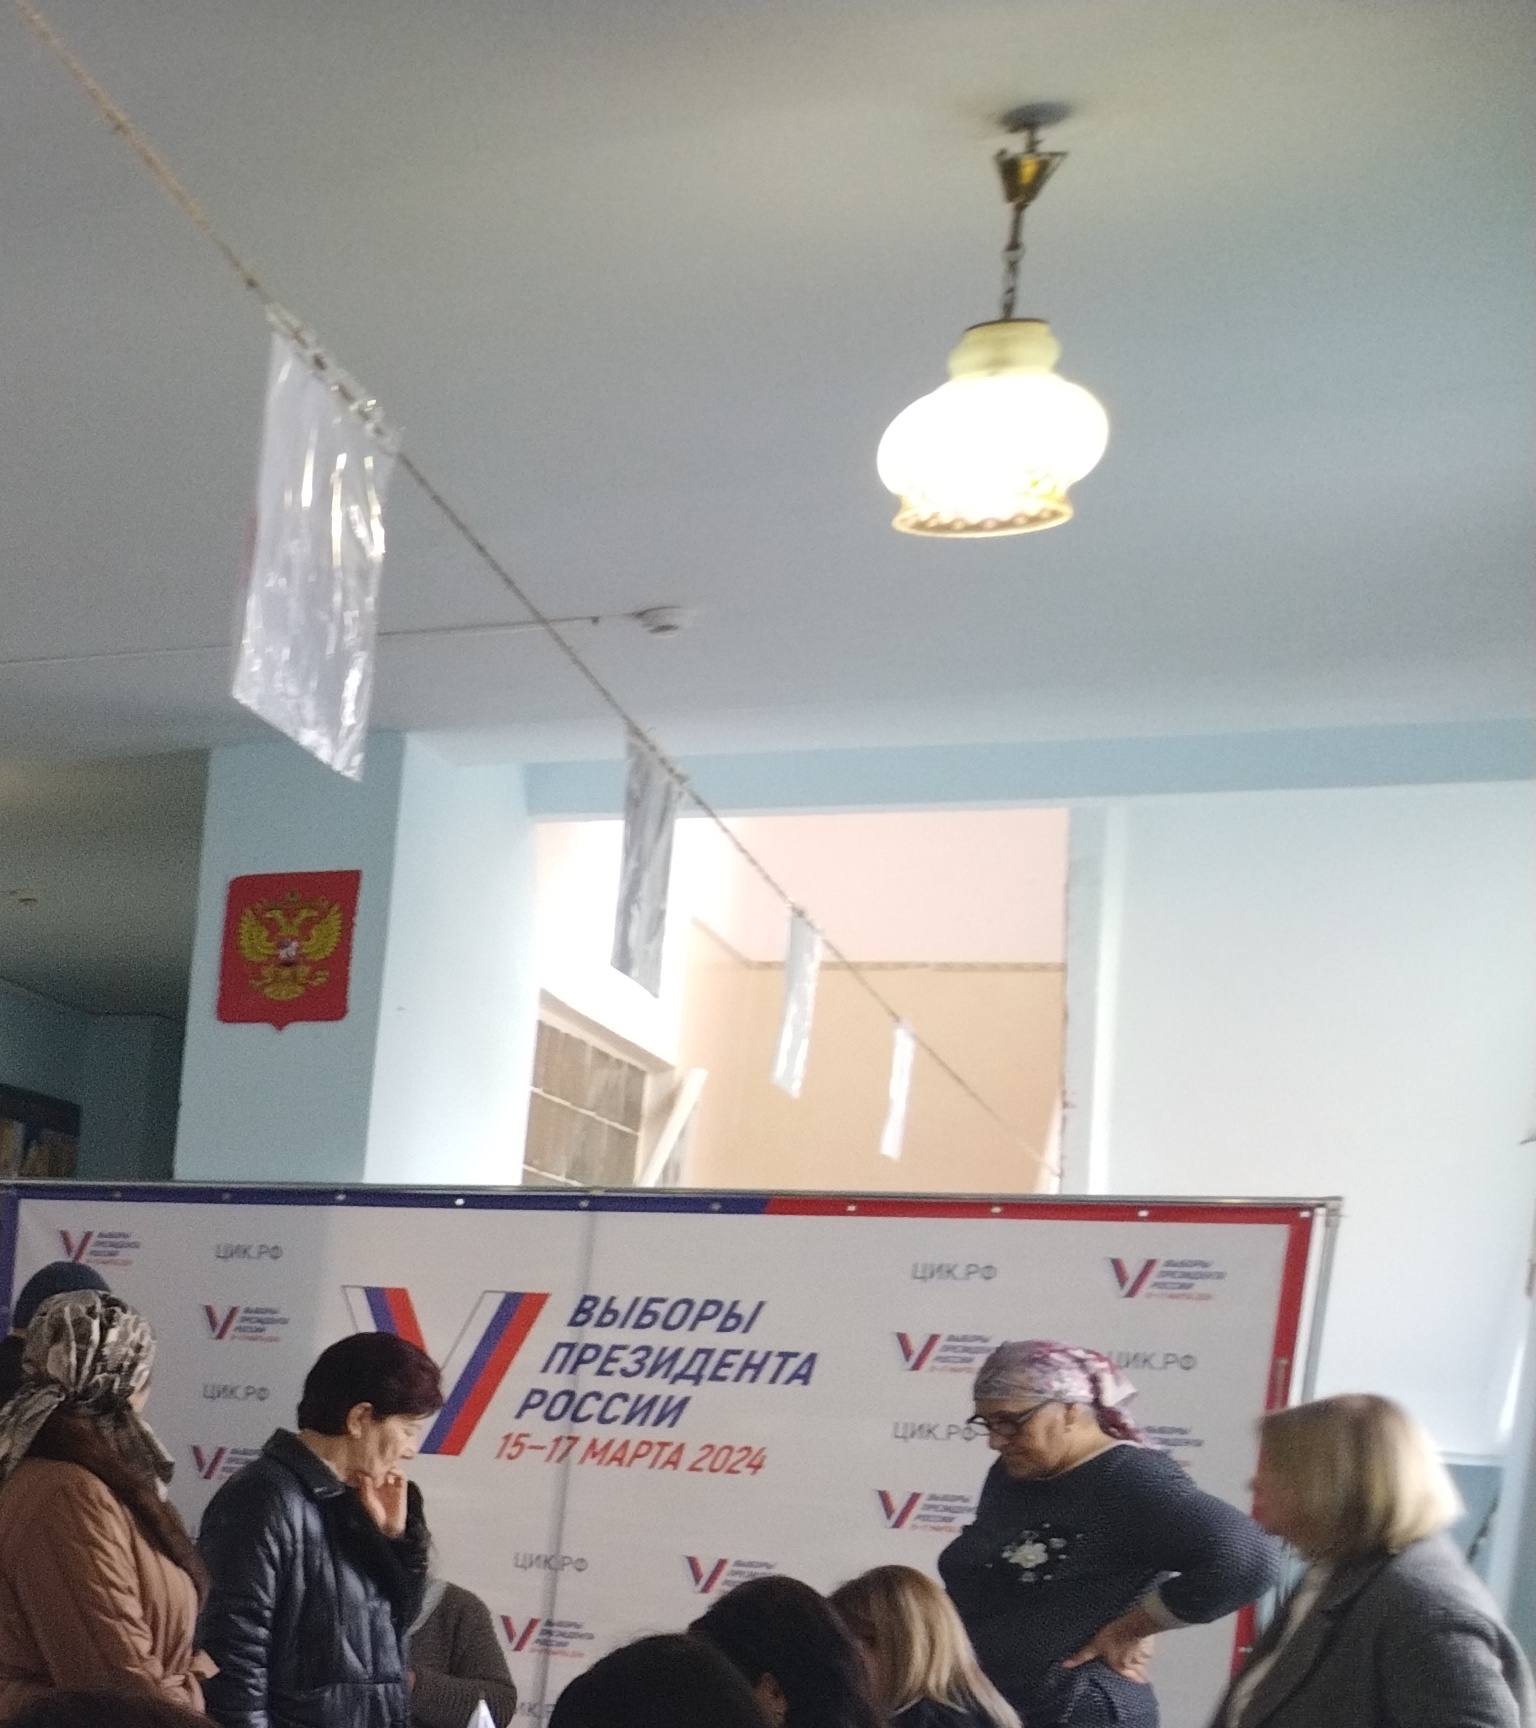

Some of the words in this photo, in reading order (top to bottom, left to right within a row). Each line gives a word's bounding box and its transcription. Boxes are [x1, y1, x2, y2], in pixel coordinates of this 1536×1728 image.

[567, 1293, 767, 1335] ВЫБОРЫ
[540, 1341, 820, 1388] ПРЕЗИДЕНТА
[515, 1388, 692, 1429] РОССИИ
[578, 1437, 681, 1472] МАРТА
[689, 1444, 768, 1477] 2024
